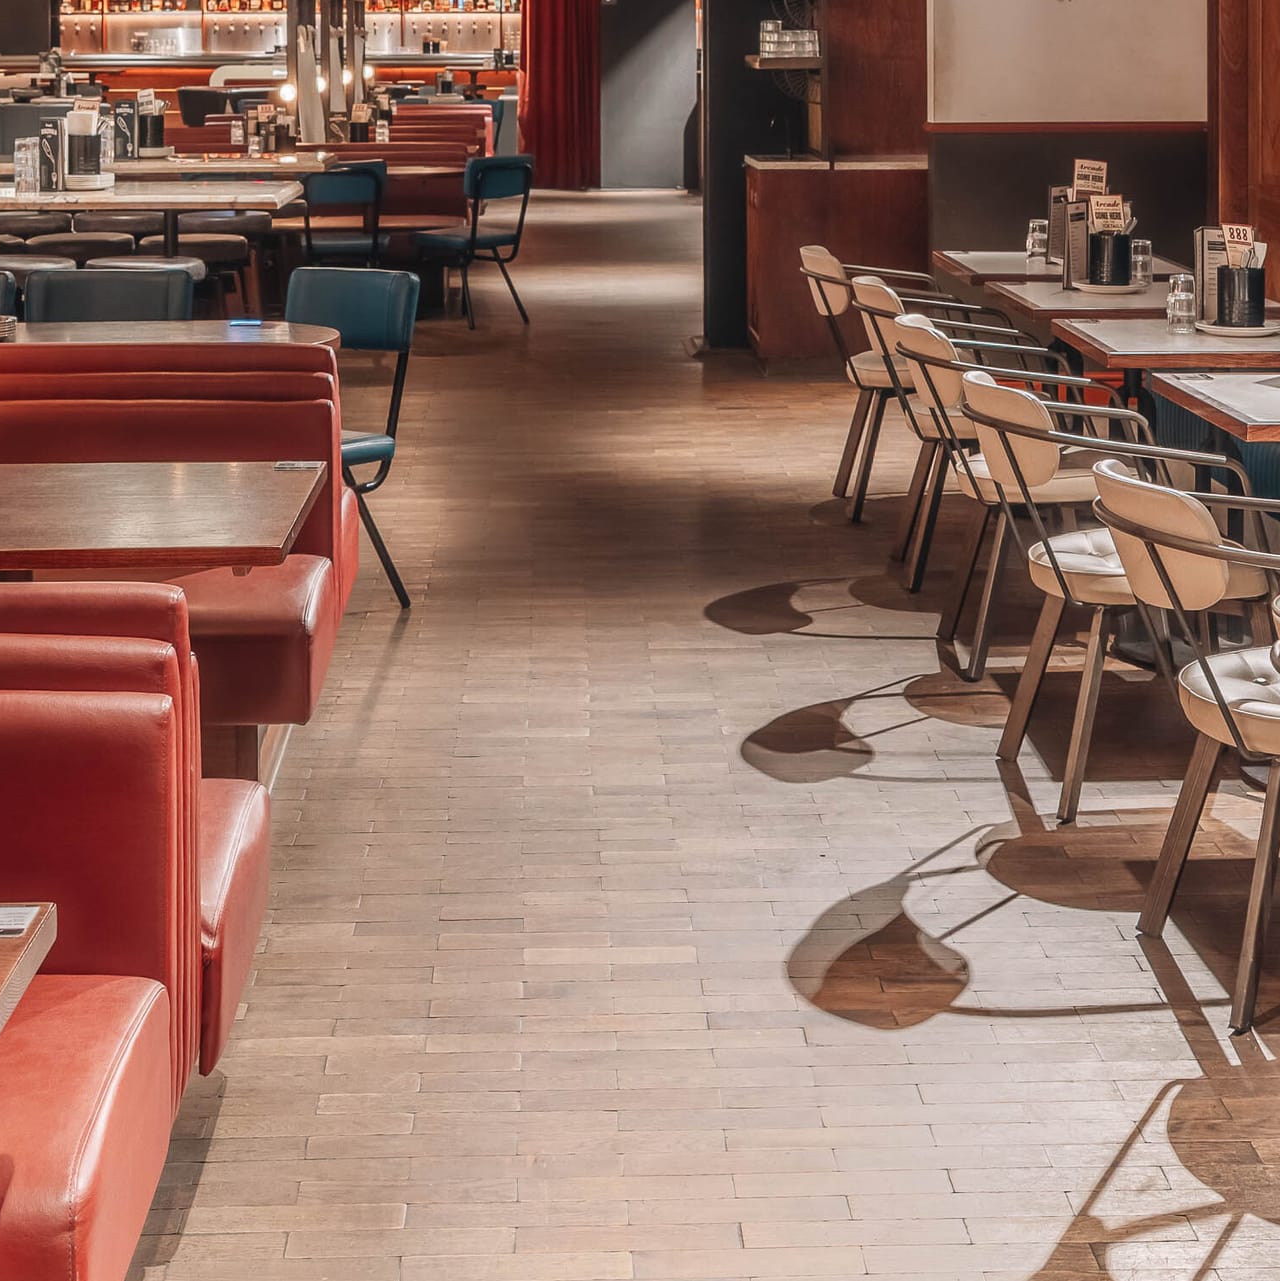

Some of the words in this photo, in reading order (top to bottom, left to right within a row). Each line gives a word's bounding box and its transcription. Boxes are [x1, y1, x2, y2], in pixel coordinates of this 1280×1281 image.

[1080, 164, 1105, 172] Arcade
[1095, 200, 1120, 208] Arcade
[1229, 227, 1248, 241] 888
